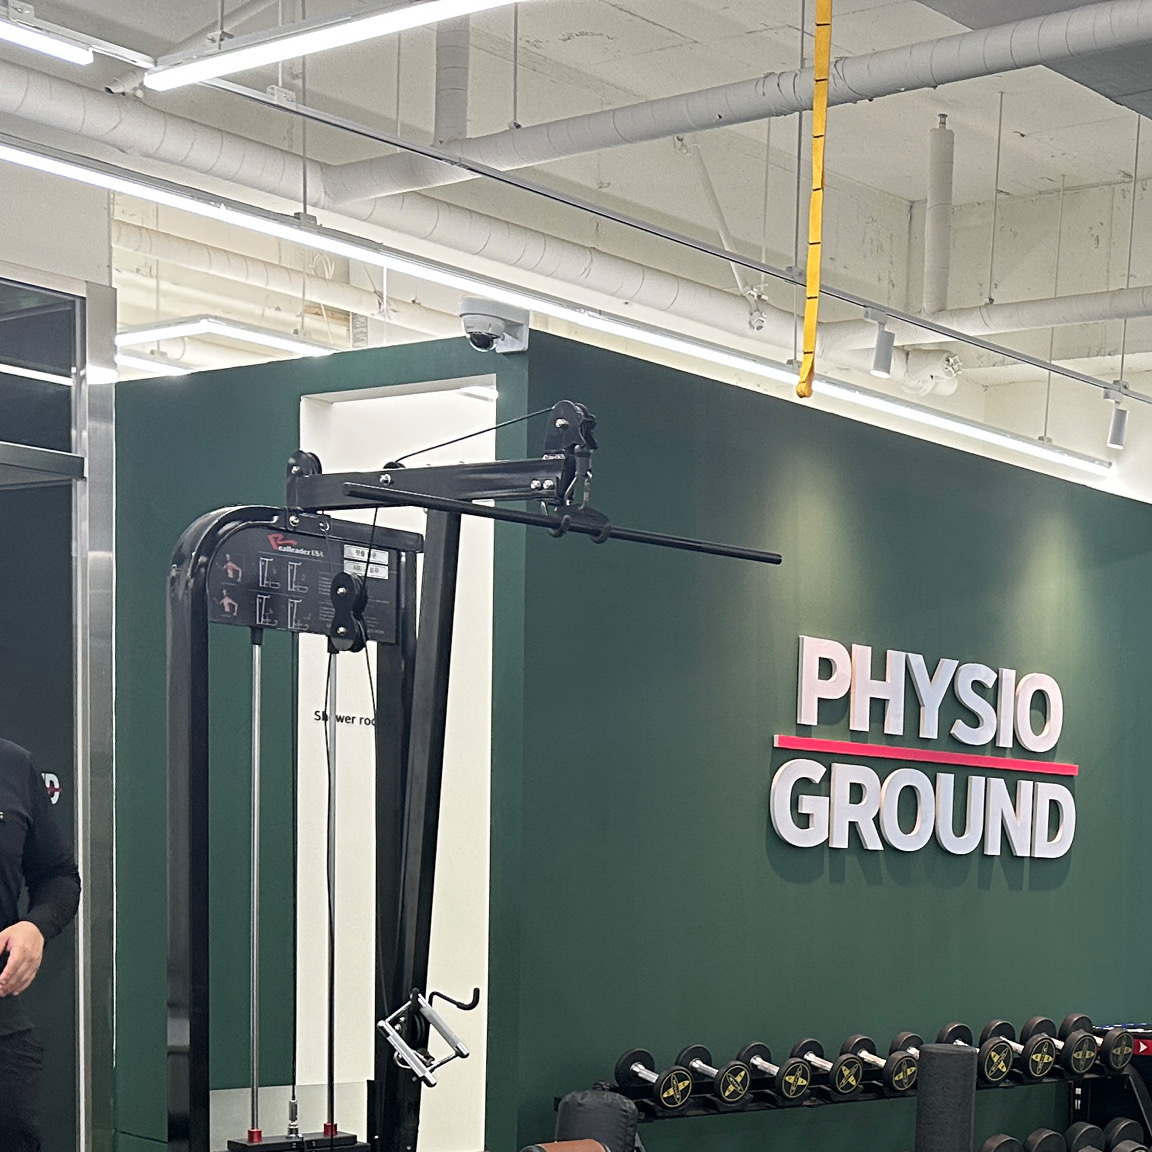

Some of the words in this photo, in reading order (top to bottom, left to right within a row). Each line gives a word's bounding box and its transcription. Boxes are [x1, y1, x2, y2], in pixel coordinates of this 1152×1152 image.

[314, 710, 357, 724] Shwer
[797, 635, 1063, 752] PHYSIO
[769, 758, 1076, 859] GROUND
